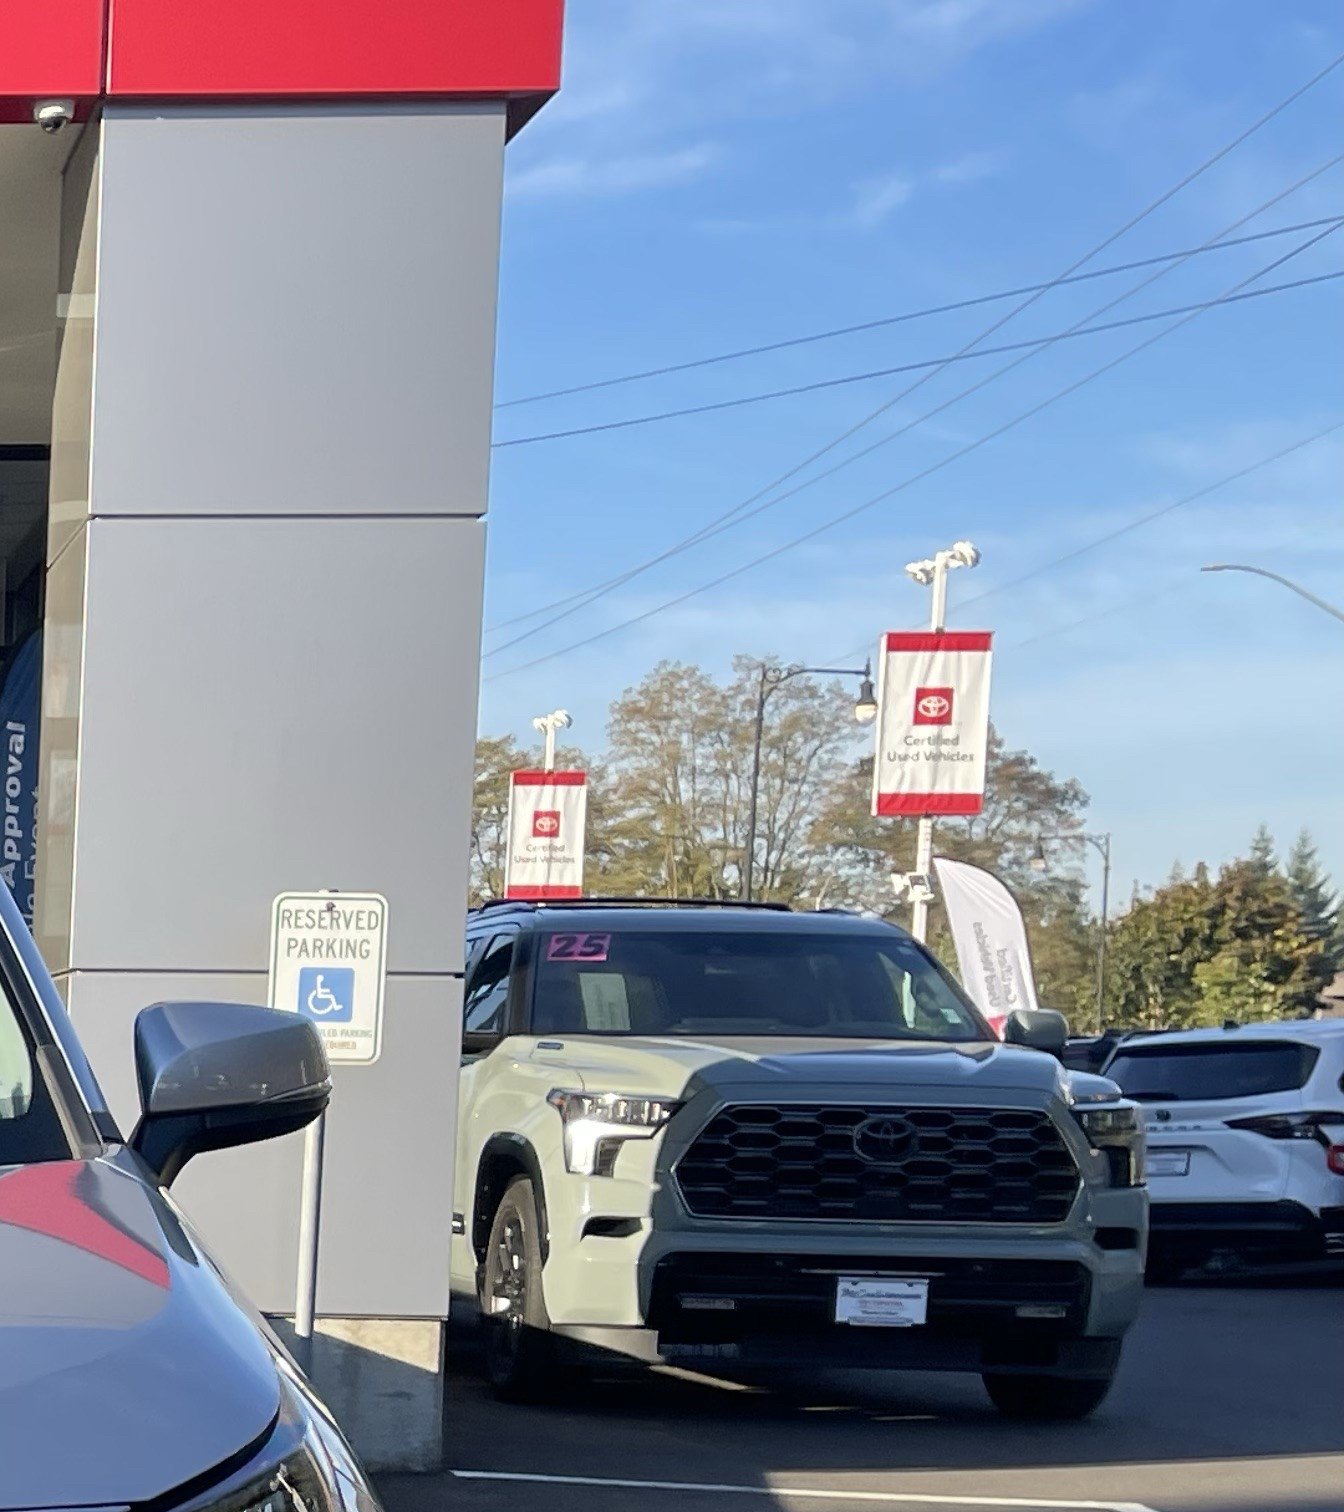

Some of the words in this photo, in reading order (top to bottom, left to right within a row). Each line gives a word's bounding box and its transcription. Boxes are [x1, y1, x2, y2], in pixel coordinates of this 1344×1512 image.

[903, 734, 960, 747] Certified
[887, 751, 920, 762] Used
[924, 751, 975, 763] Vehicles
[0, 721, 26, 889] Approval
[280, 909, 379, 931] RESERVED
[286, 938, 371, 959] PARKING
[551, 935, 608, 957] 25
